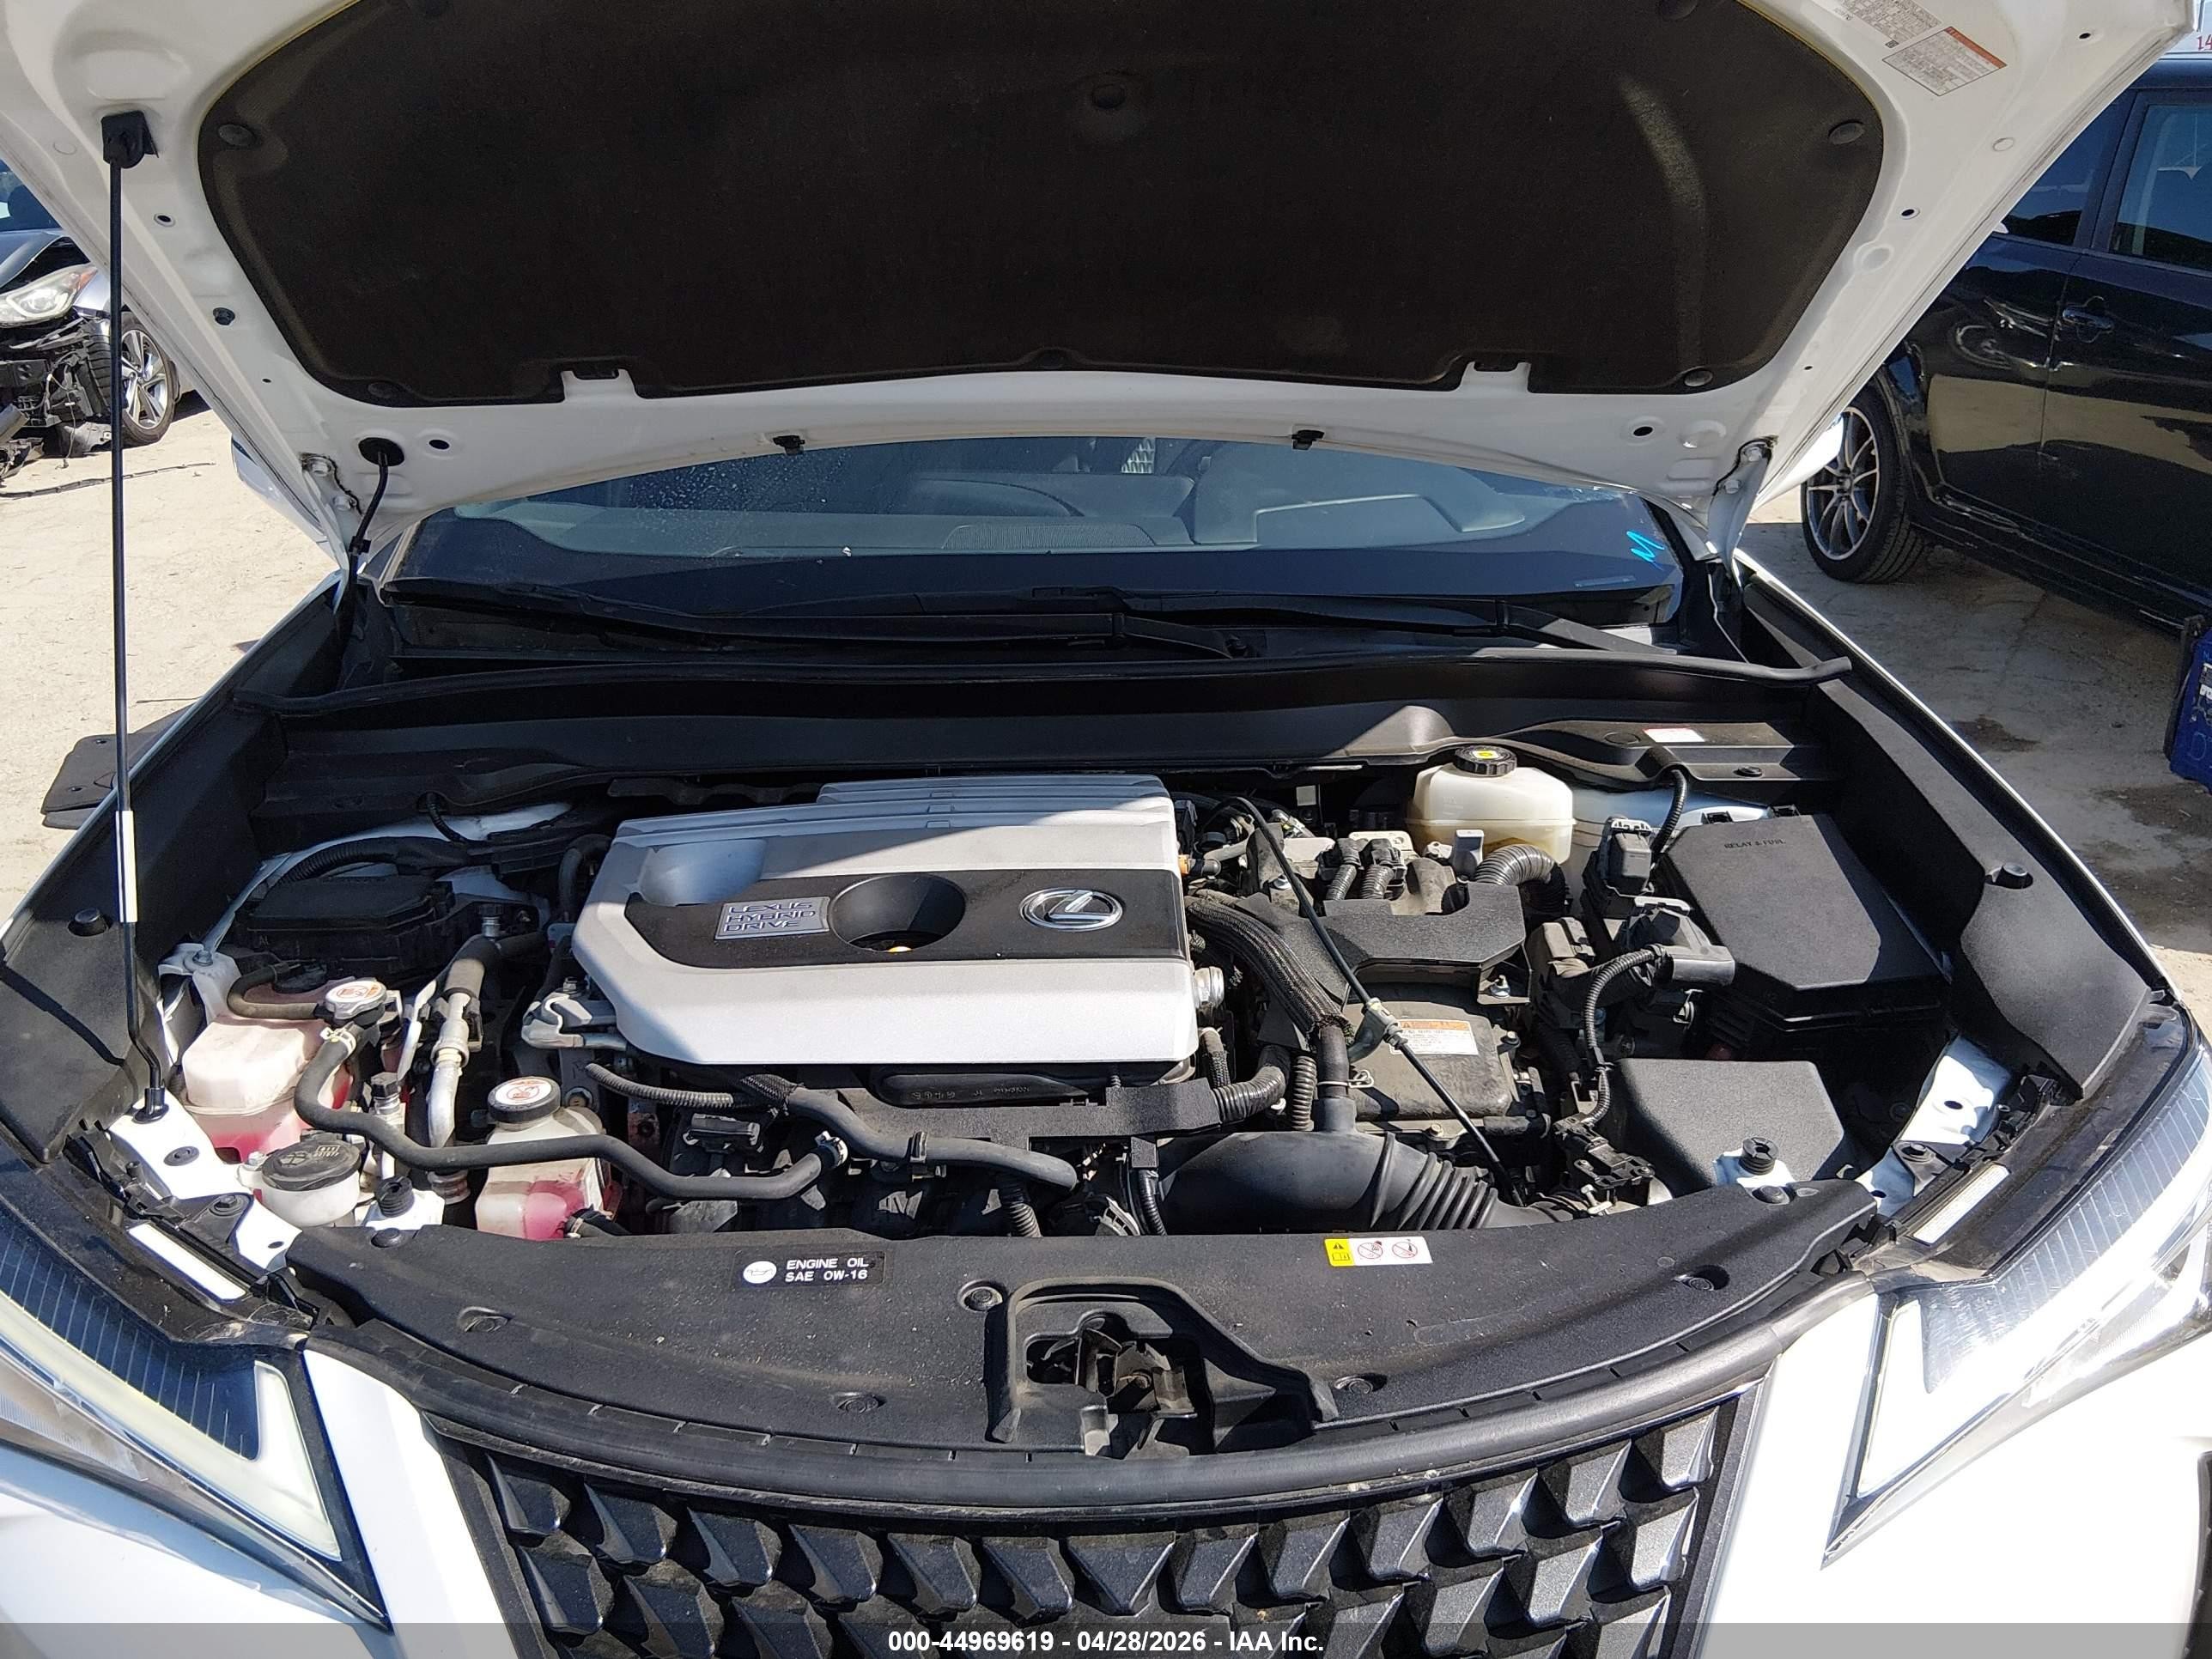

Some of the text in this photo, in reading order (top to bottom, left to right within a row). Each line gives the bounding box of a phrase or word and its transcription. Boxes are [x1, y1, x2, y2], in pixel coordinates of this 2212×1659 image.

[728, 902, 812, 914] LEXUS
[726, 910, 816, 923] HYBRID
[723, 920, 800, 933] DRIVE
[786, 1257, 869, 1270] ENGINE OIL
[785, 1271, 814, 1282] SAE
